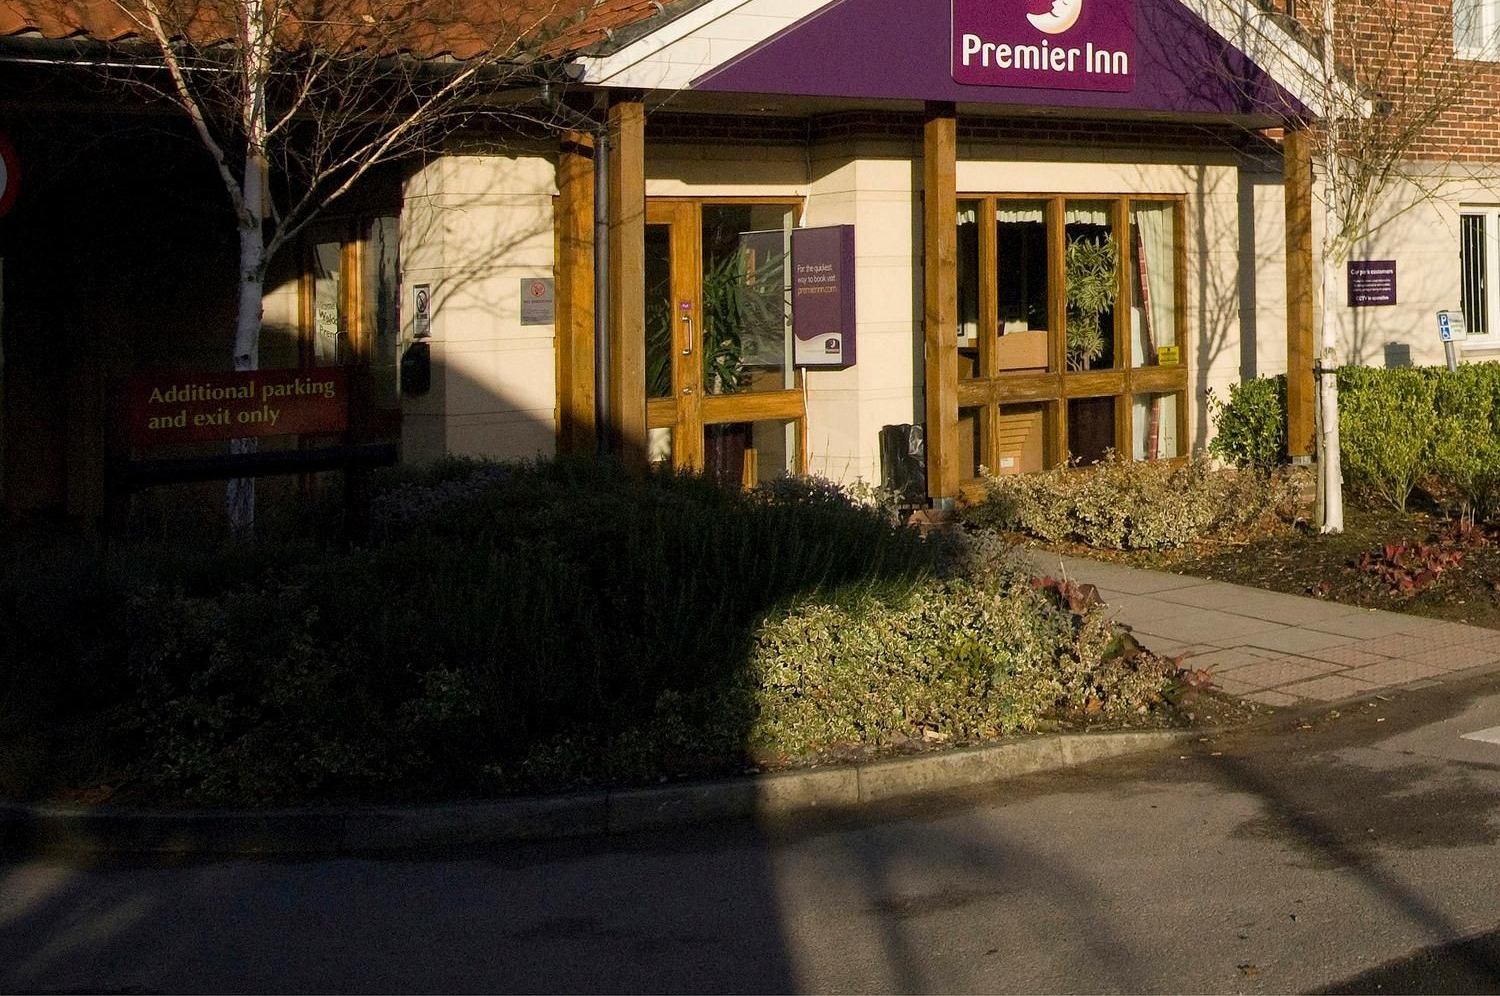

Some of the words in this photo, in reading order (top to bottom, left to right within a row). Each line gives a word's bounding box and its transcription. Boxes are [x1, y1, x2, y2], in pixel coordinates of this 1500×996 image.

[962, 33, 1081, 72] Premier
[1086, 42, 1128, 75] Inn
[814, 274, 826, 283] book
[148, 380, 255, 404] Additional
[262, 377, 336, 402] parking
[148, 409, 187, 430] and
[193, 407, 231, 426] exit
[237, 404, 281, 427] only
